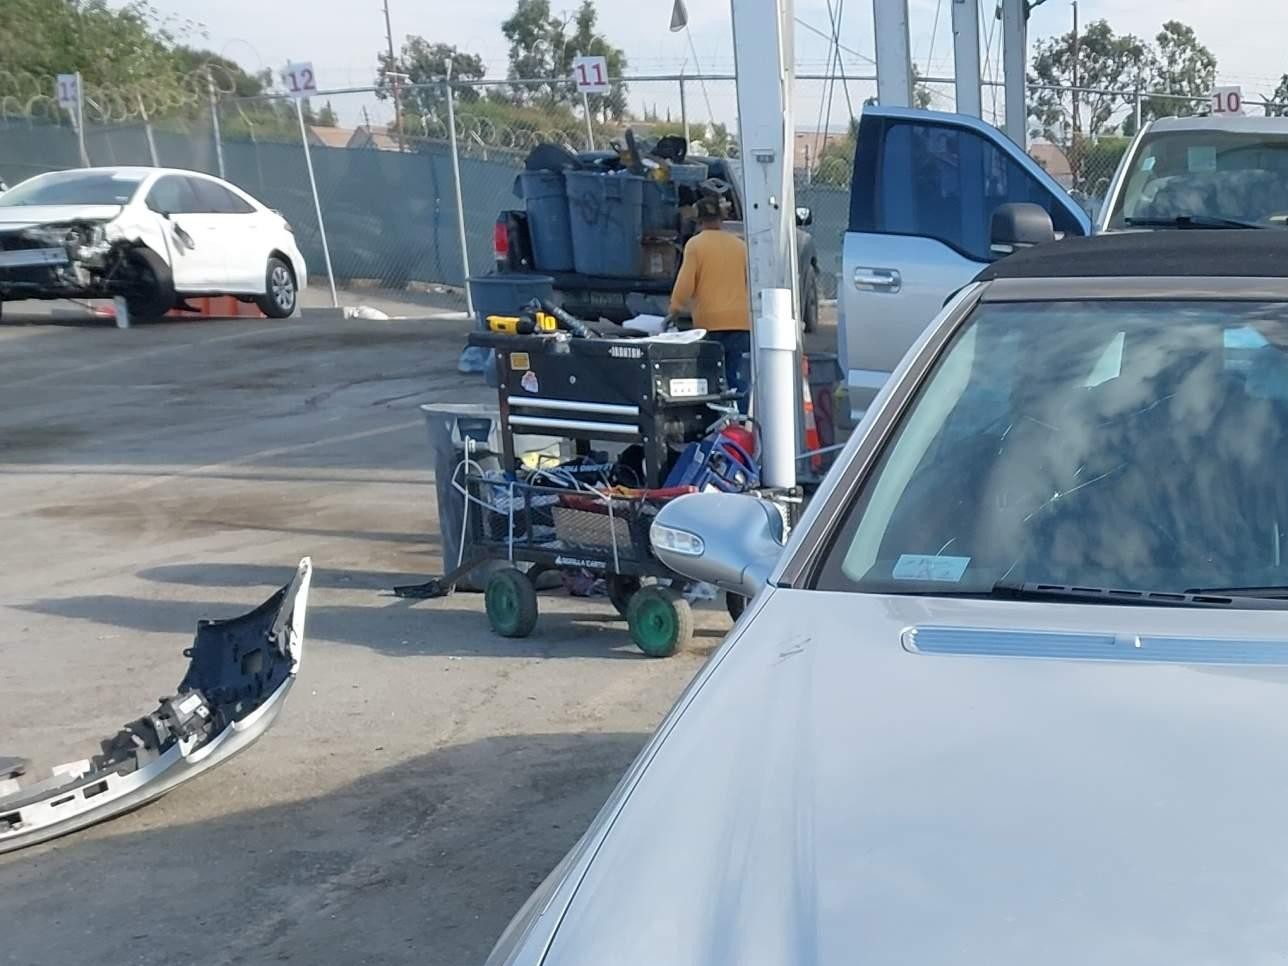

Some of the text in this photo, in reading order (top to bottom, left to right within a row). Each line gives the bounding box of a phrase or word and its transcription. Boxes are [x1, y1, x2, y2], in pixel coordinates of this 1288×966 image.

[288, 69, 316, 92] 12
[576, 63, 606, 86] 11
[1212, 91, 1240, 113] 10
